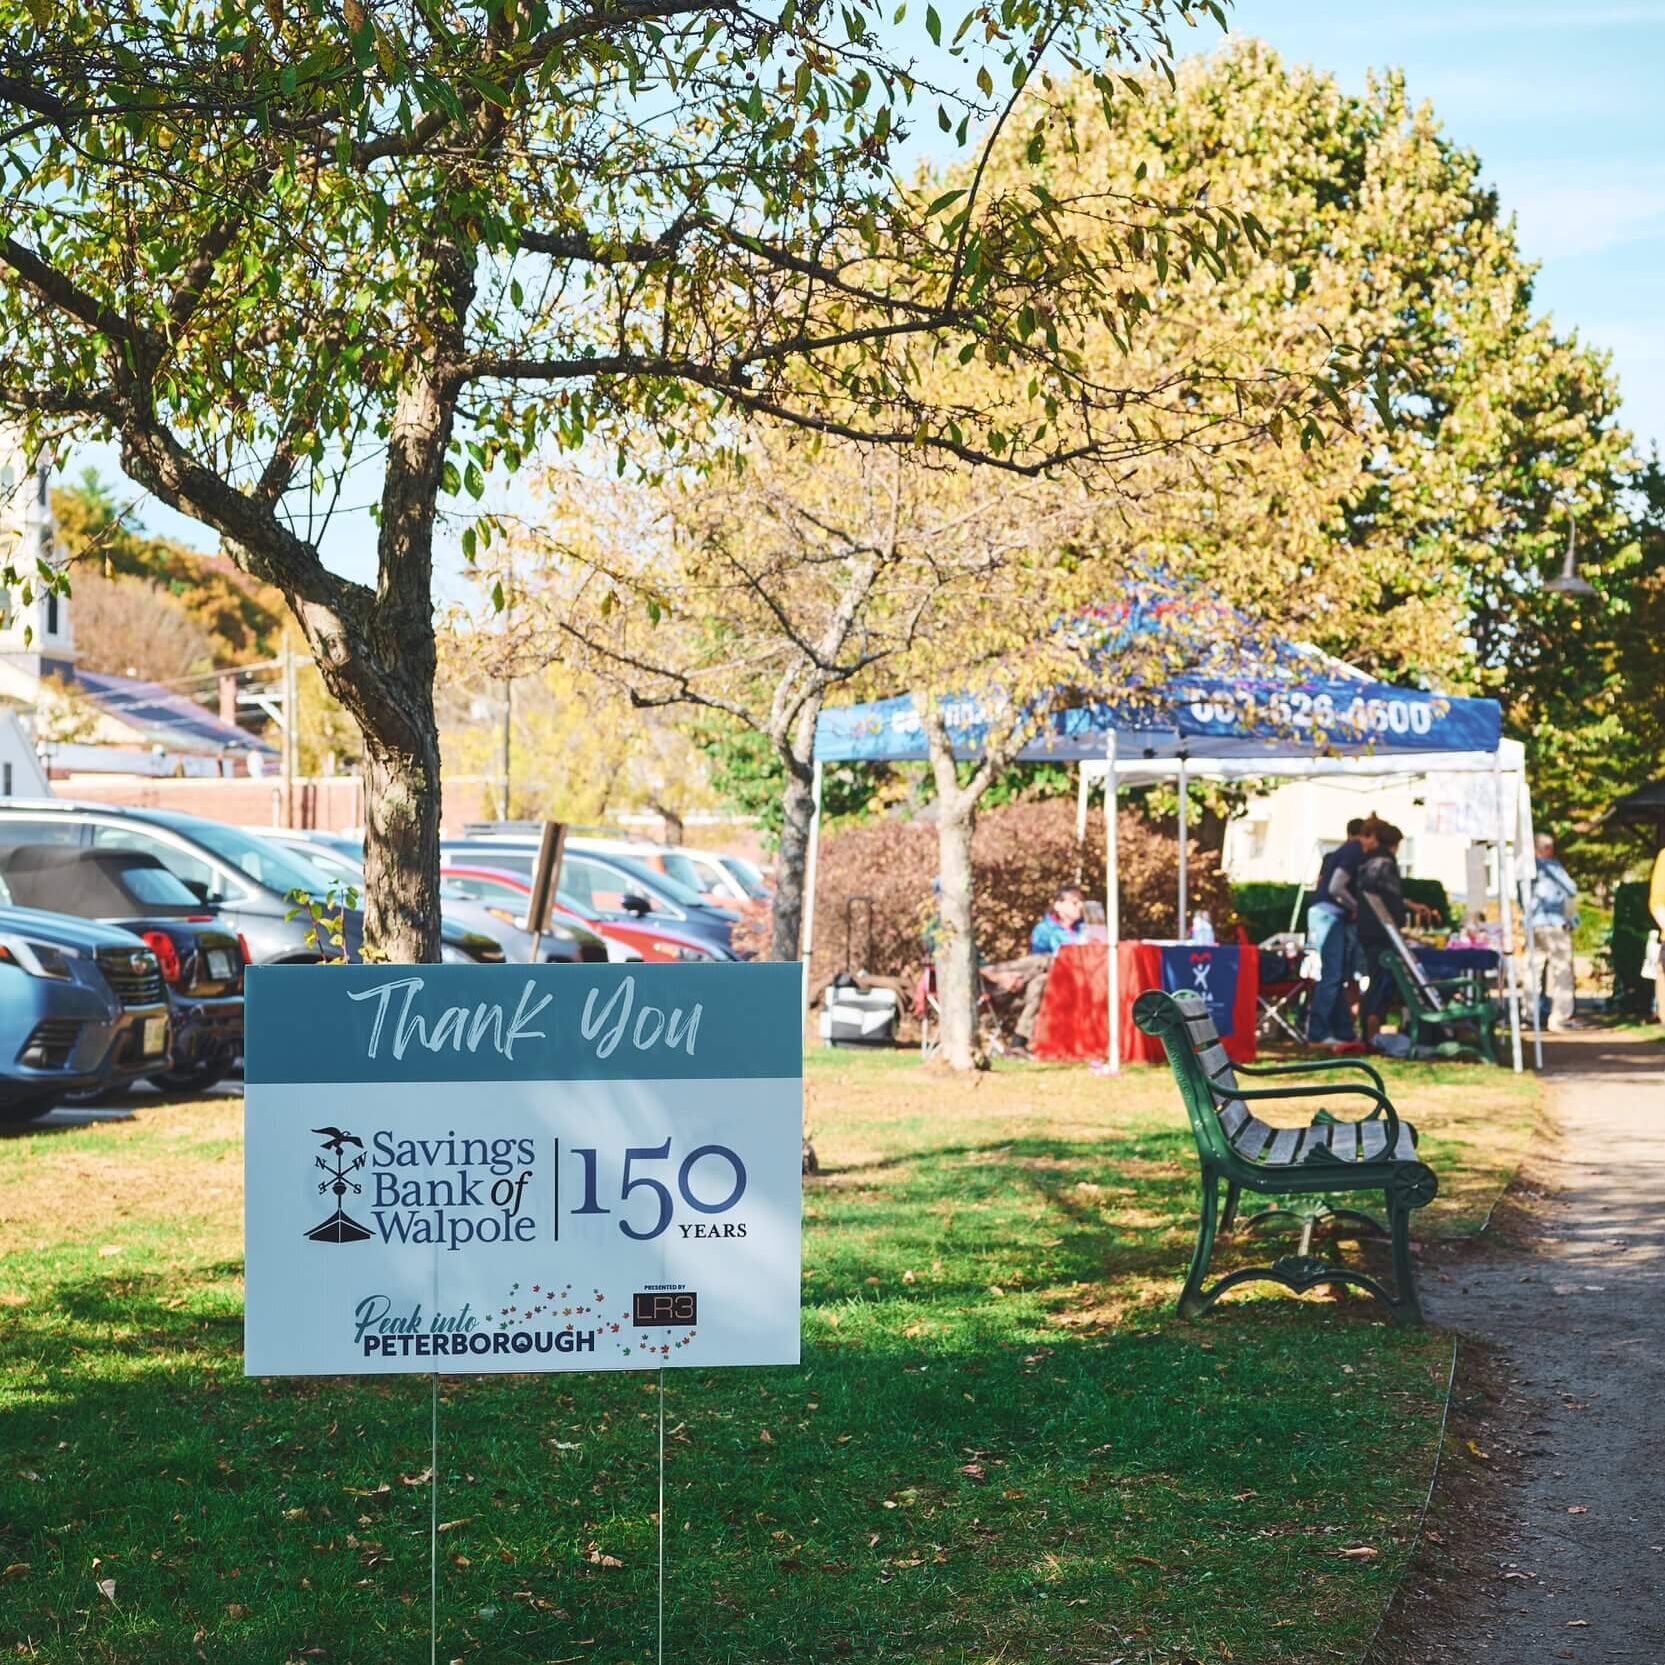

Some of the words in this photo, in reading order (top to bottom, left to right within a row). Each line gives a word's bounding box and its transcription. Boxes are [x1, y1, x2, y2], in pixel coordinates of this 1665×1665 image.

[346, 976, 553, 1061] Thank
[580, 975, 704, 1059] You
[371, 1130, 536, 1175] Savings
[371, 1171, 485, 1208] Bank
[490, 1171, 533, 1218] of
[570, 1136, 748, 1241] 150
[371, 1209, 537, 1251] Walpole
[678, 1223, 748, 1239] YEARS
[354, 1294, 423, 1344] Peak
[429, 1302, 480, 1333] into
[636, 1295, 694, 1320] LR3
[363, 1330, 596, 1357] PETERBOROUGH
